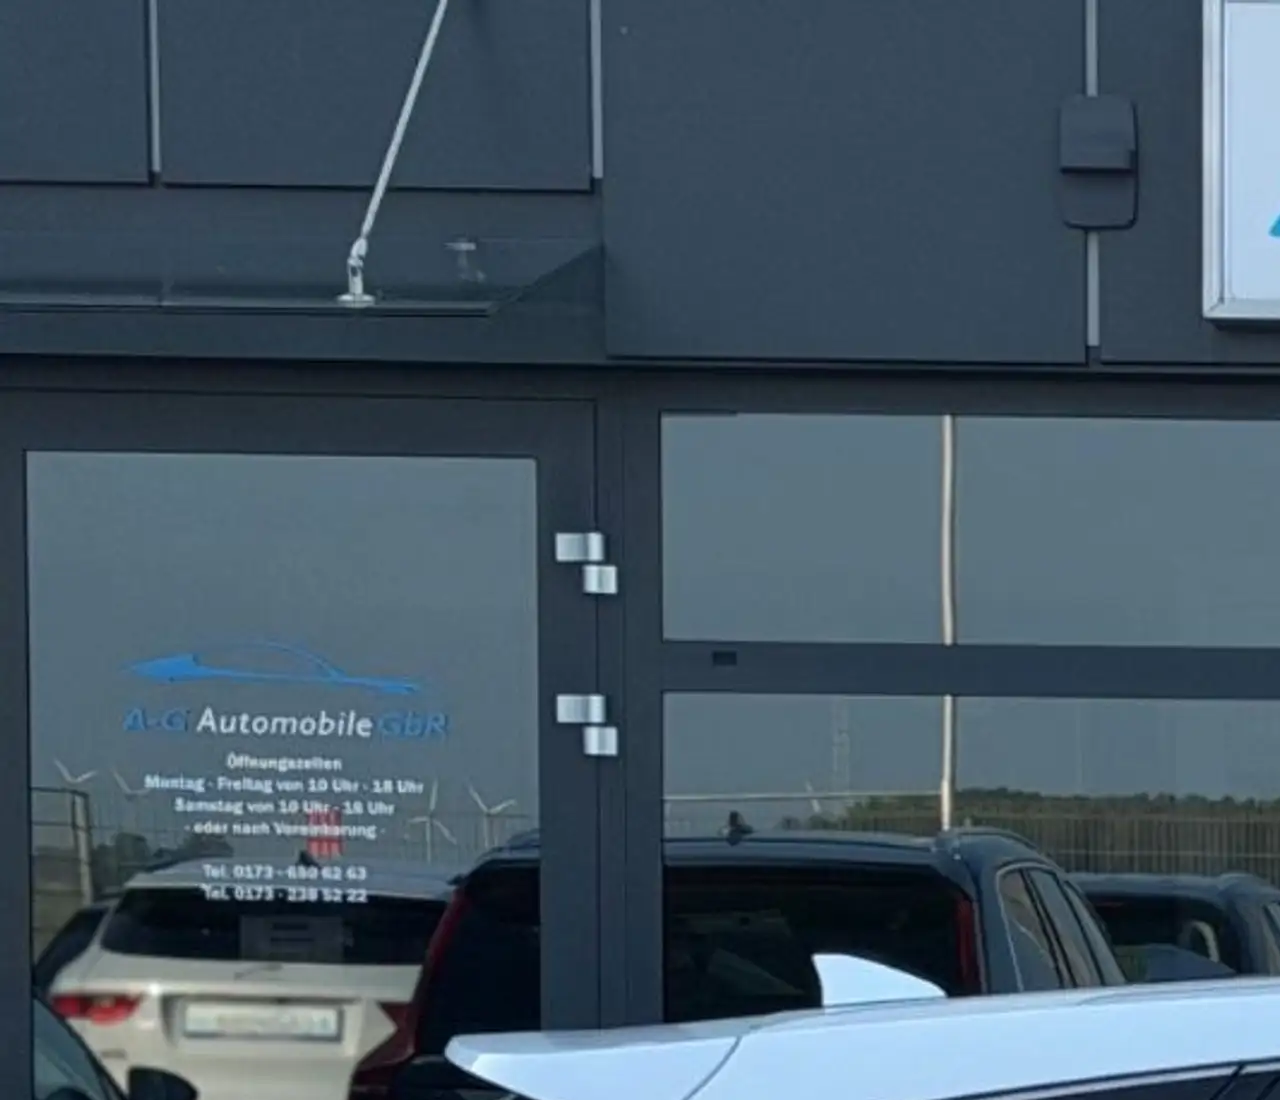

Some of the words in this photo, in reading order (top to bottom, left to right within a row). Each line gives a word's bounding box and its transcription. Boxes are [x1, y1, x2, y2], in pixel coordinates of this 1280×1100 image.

[196, 706, 373, 738] Automobile
[378, 710, 447, 737] GbR
[144, 774, 205, 792] Montag
[217, 776, 273, 793] Freitag
[276, 780, 303, 792] von
[308, 778, 328, 792] 10
[332, 778, 359, 793] Uhr
[397, 779, 424, 794] Uhr
[175, 796, 243, 815] Samstag
[246, 801, 274, 813] von
[303, 799, 331, 813] Uhr
[367, 800, 395, 815] Uhr
[193, 821, 228, 834] oder
[232, 821, 270, 835] nach
